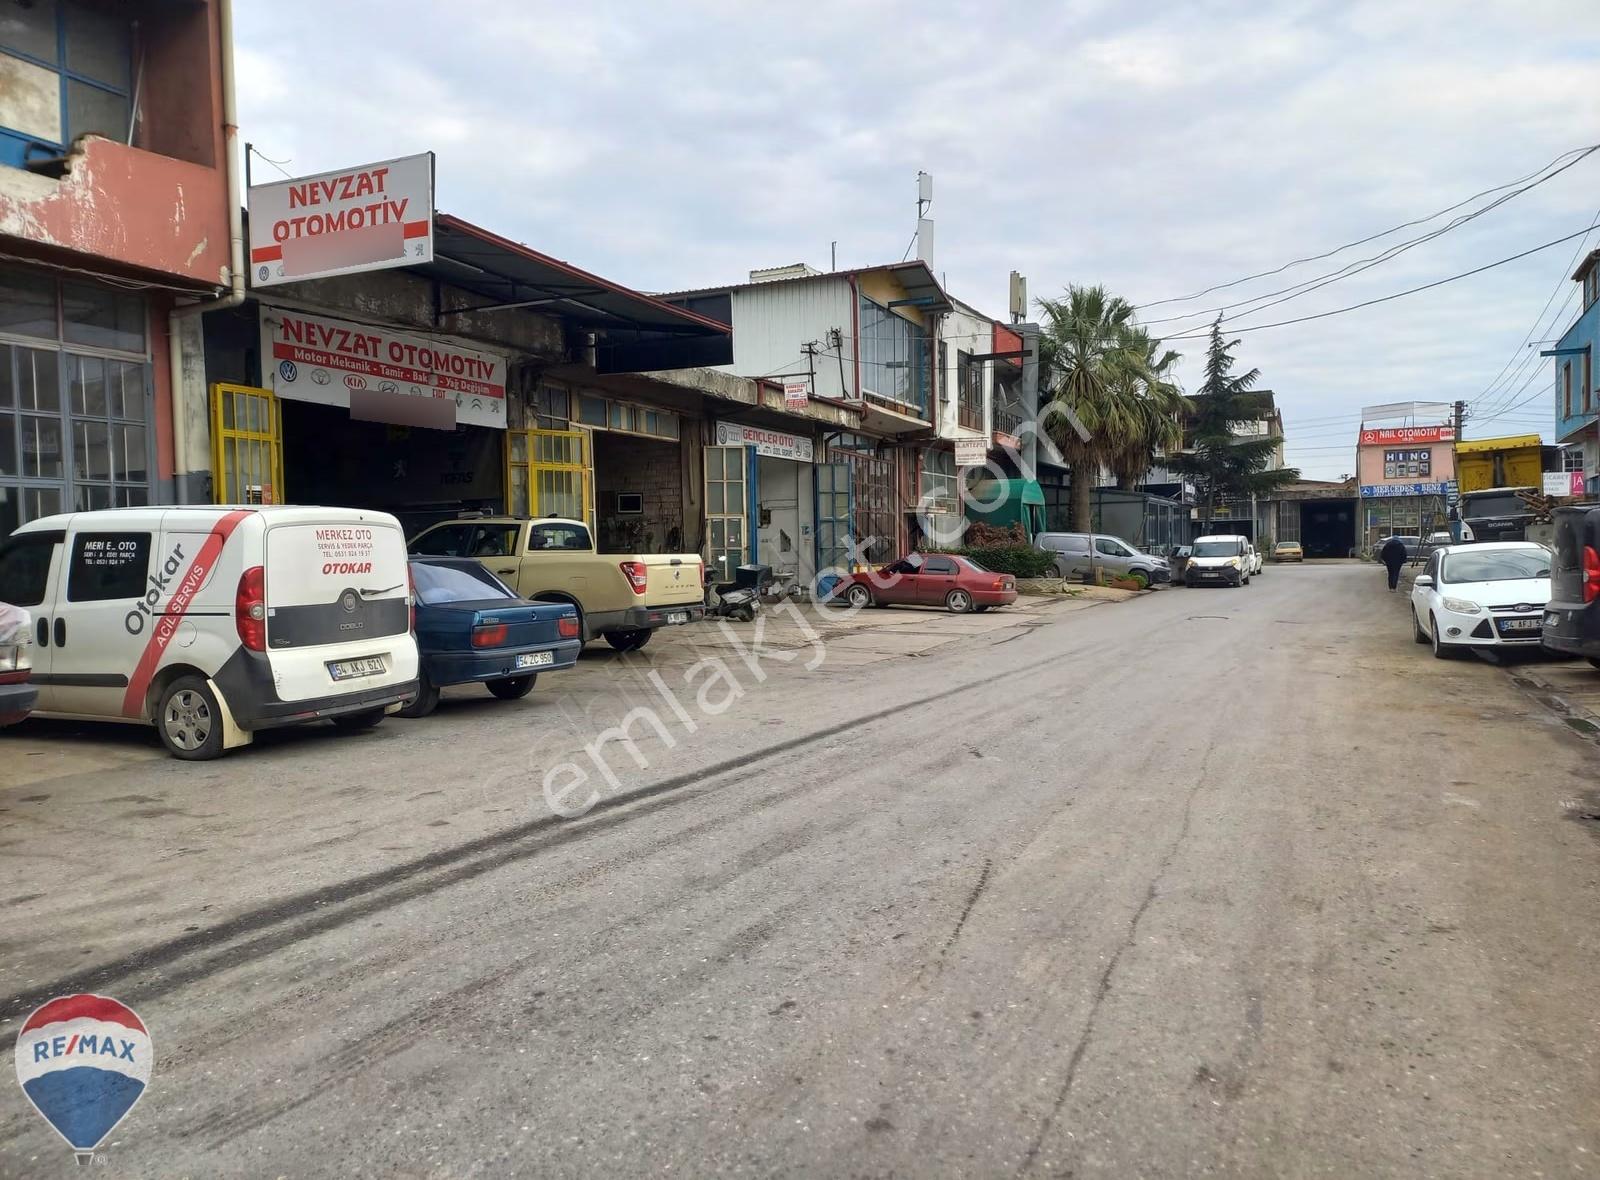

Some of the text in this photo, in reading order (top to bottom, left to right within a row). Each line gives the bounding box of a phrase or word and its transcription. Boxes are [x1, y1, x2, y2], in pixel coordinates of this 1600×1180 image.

[288, 167, 389, 209] NEVZAT
[272, 194, 409, 243] OTOMOTİV
[282, 317, 496, 381] NEVZAT OTOMOTİV
[294, 347, 327, 364] Motor
[330, 354, 371, 372] Mekanik
[380, 364, 405, 378] Tamir
[742, 428, 794, 447] GENÇLER OTO
[1373, 484, 1415, 493] MERCEDES
[118, 541, 137, 551] OTO
[315, 529, 372, 540] MERKEZ OTO
[322, 562, 372, 575] OTOKAR
[125, 543, 185, 635] Otokar
[171, 564, 204, 614] SERVİS
[519, 655, 529, 666] 54
